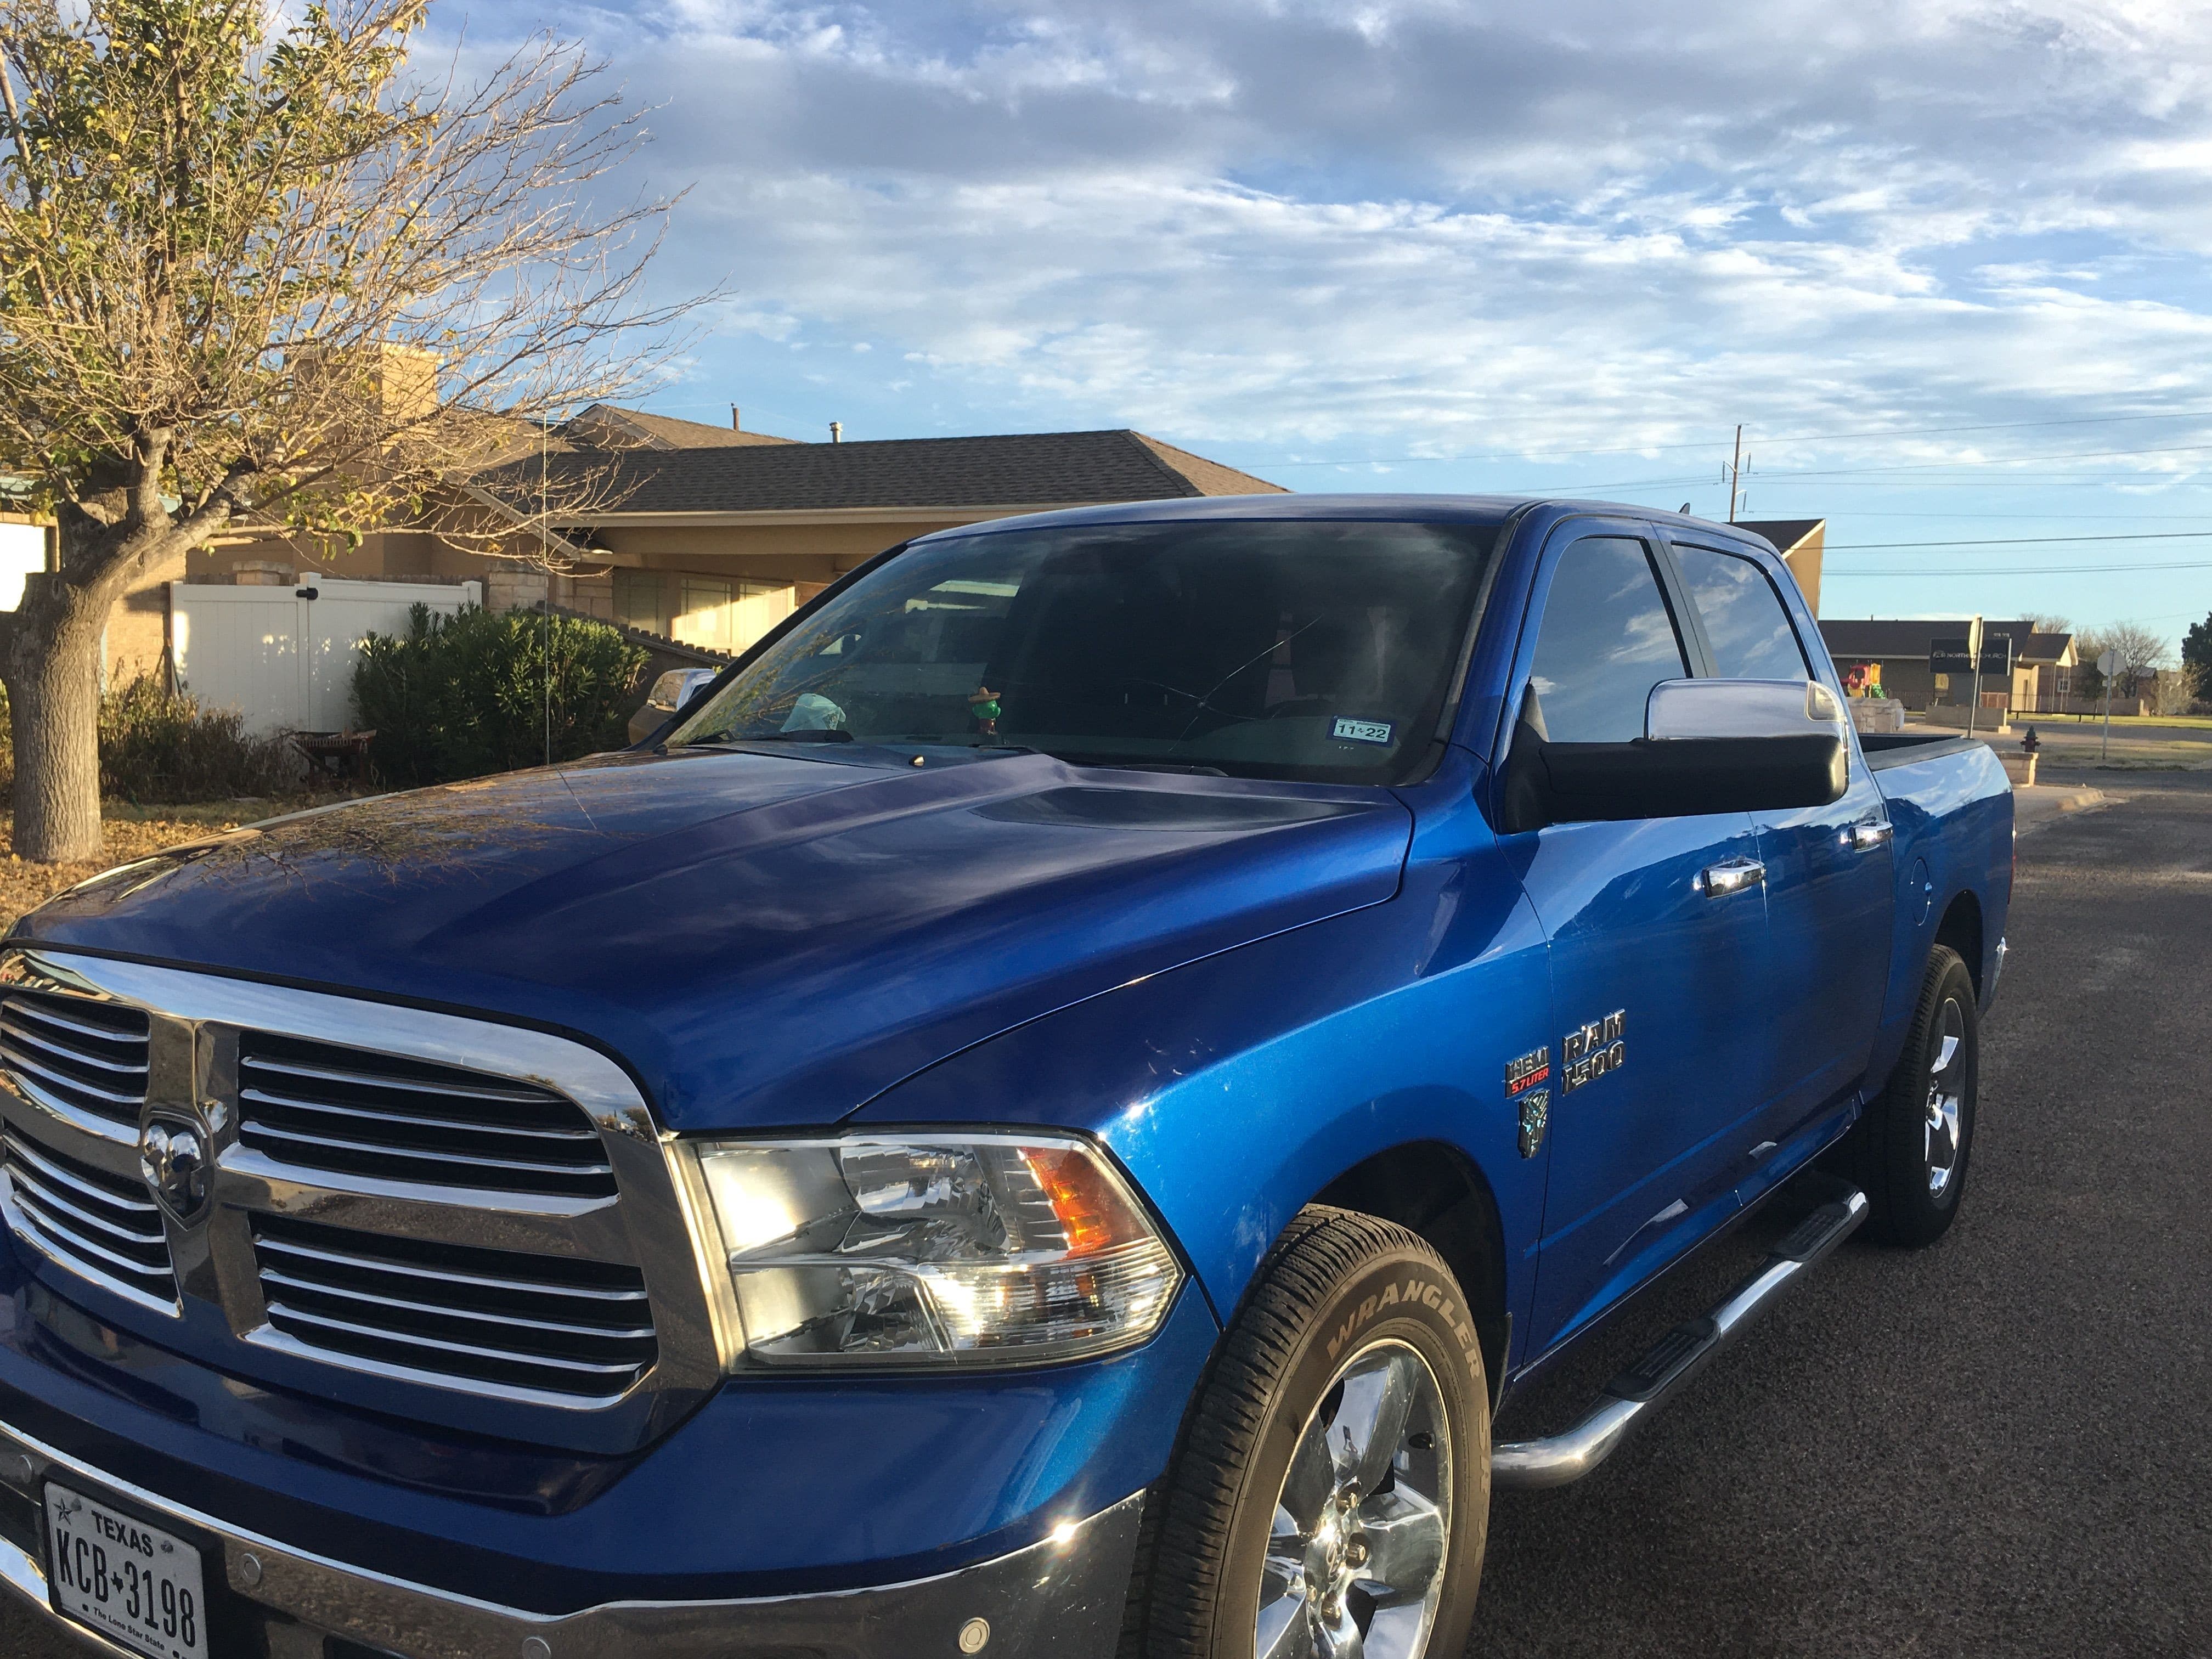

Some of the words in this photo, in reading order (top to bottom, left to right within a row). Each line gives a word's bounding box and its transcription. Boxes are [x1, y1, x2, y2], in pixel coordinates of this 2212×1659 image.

[1339, 724, 1356, 735] 11
[1365, 727, 1386, 738] 22
[1562, 1008, 1625, 1063] RAM
[1526, 1068, 1549, 1087] LITER
[1562, 1040, 1624, 1097] 1500
[1327, 1280, 1480, 1380] WRANGLER
[91, 1510, 154, 1557] TEXAS
[57, 1528, 109, 1603] KCB
[125, 1560, 195, 1647] 3198
[93, 1607, 106, 1620] The
[109, 1615, 126, 1630] Lone
[128, 1625, 143, 1639] Star
[145, 1634, 165, 1650] State
